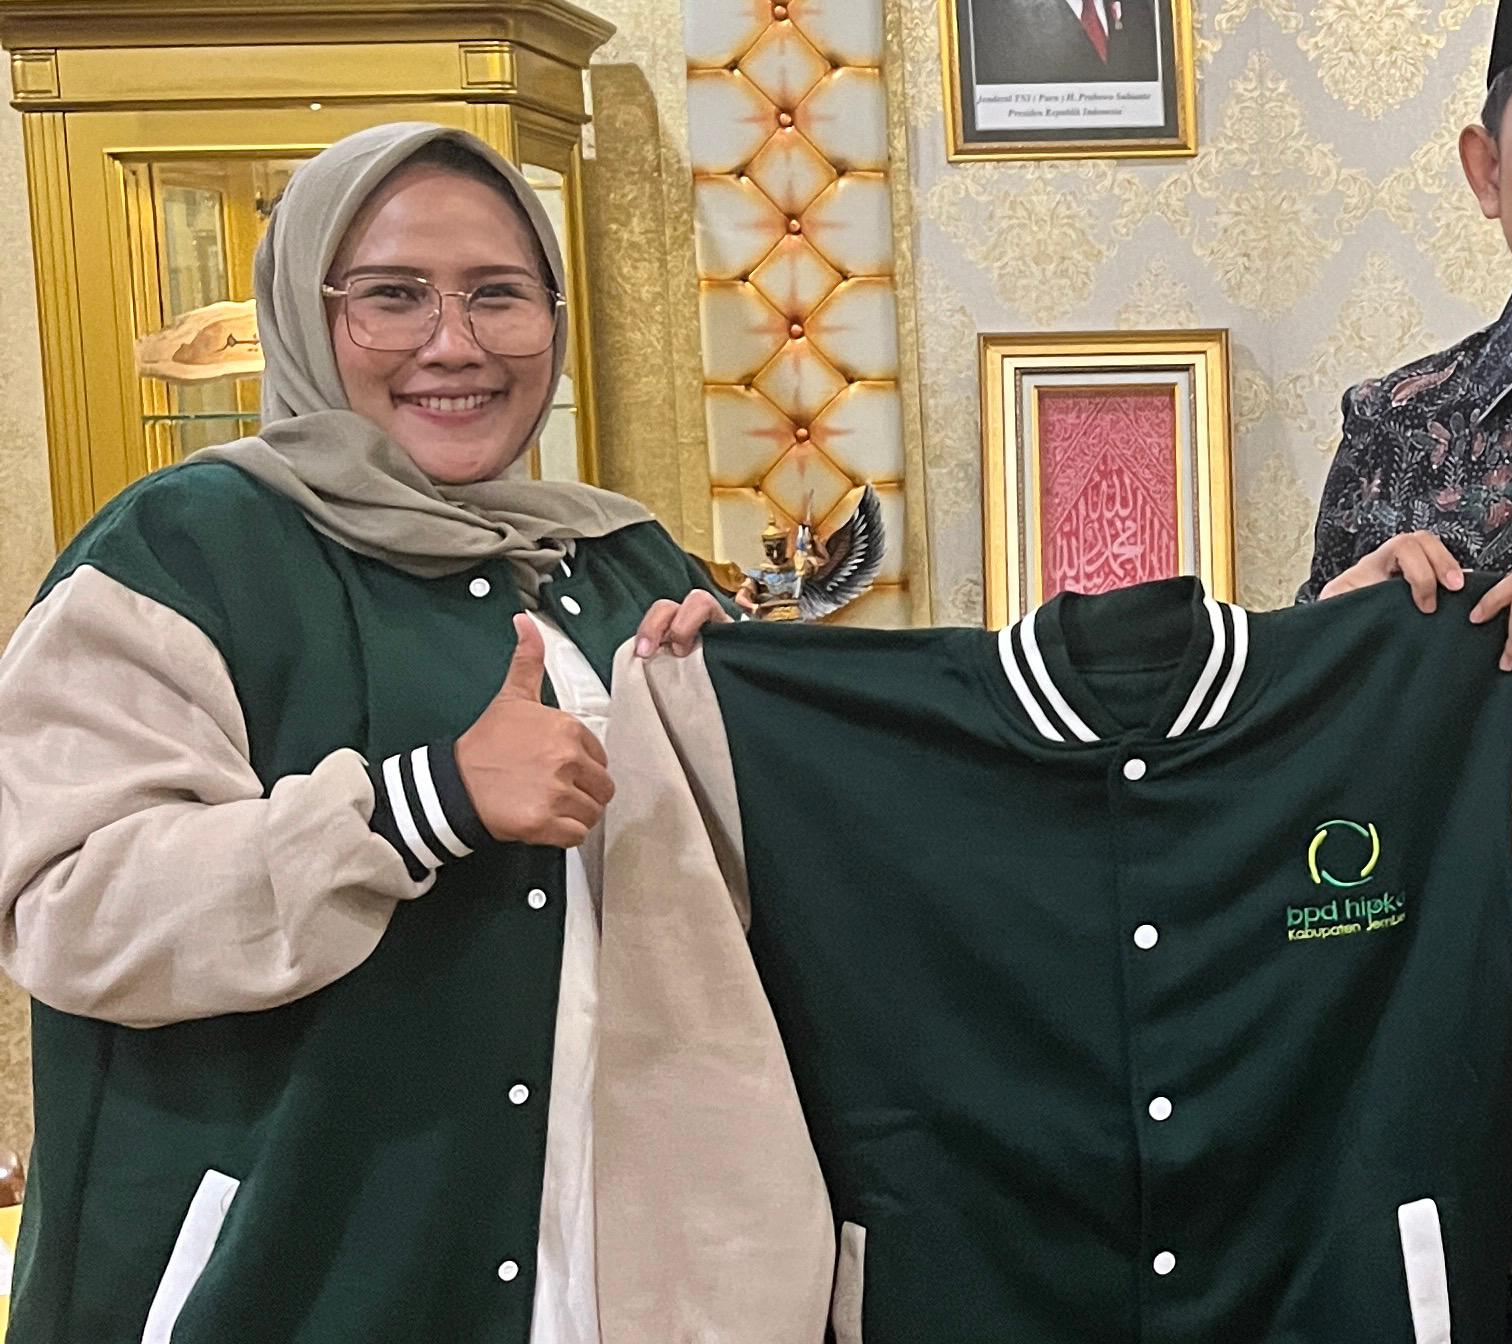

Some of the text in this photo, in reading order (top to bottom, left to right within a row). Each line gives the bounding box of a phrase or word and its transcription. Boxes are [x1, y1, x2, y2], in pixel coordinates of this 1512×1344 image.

[1287, 900, 1338, 929] bpd
[1288, 913, 1405, 940] Kabupaten Jembe
